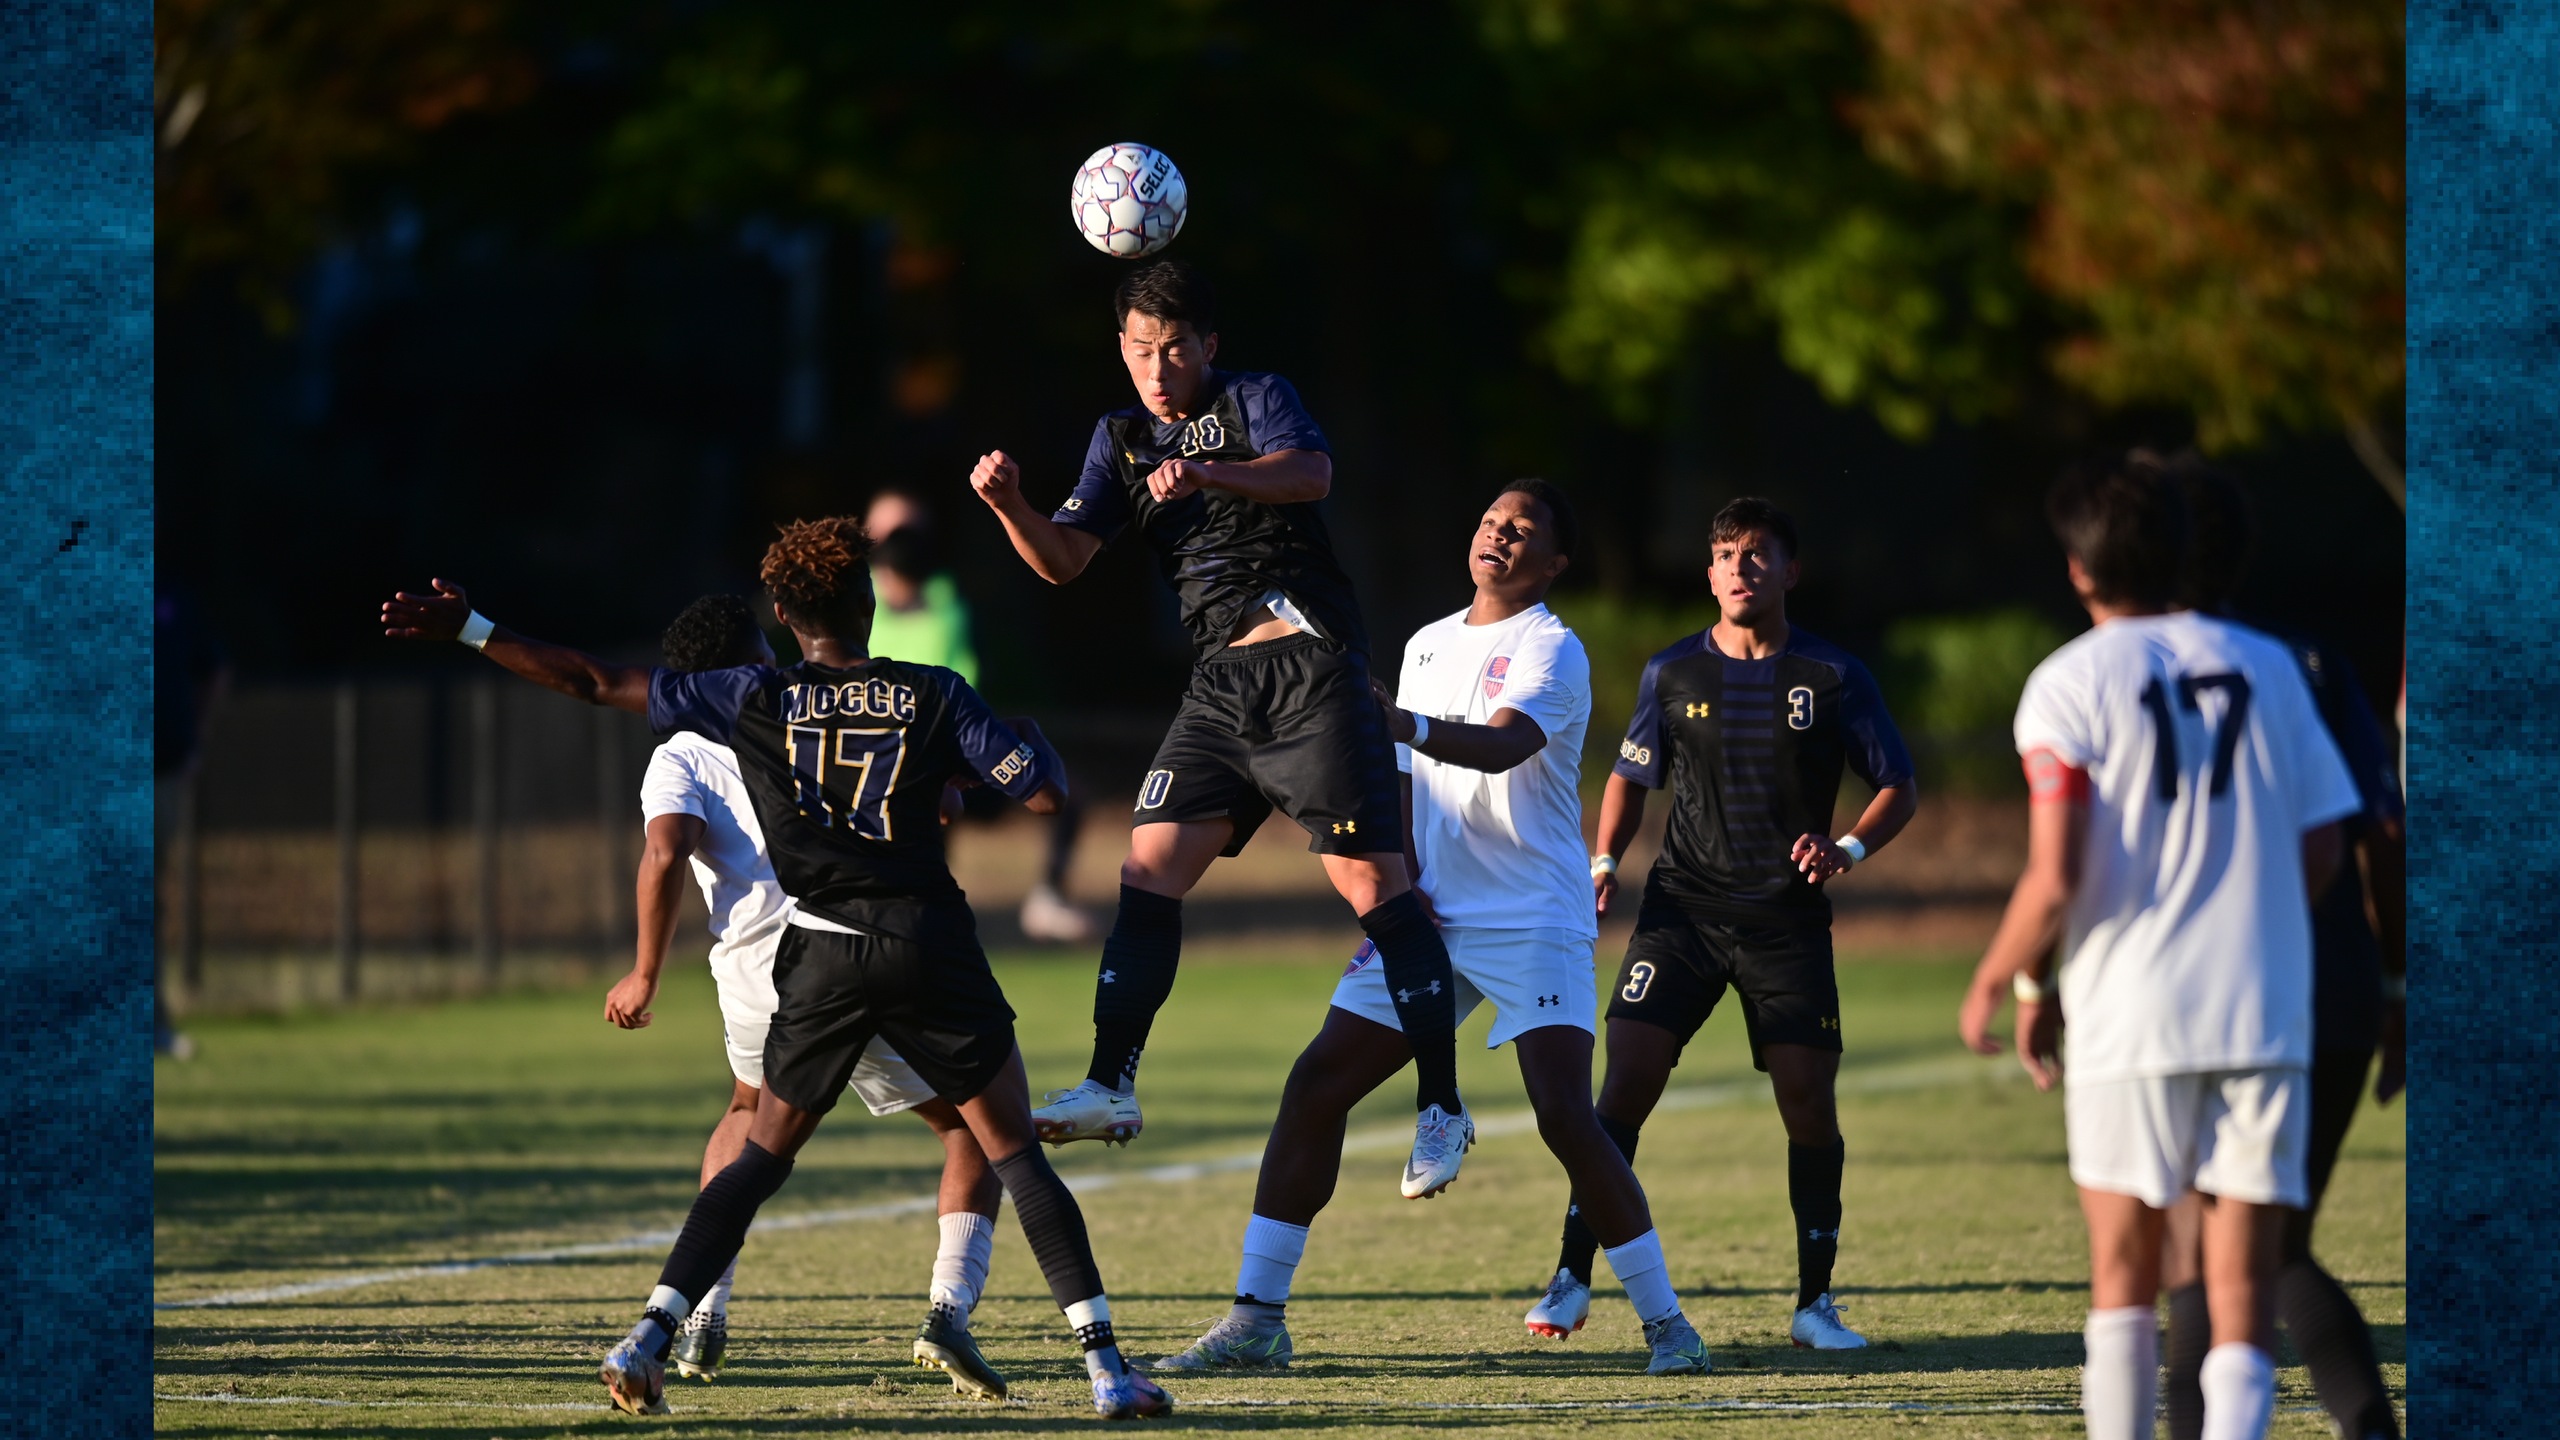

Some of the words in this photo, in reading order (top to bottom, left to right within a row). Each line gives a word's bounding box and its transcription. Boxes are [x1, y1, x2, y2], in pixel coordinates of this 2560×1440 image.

[1181, 414, 1224, 457] 10
[1787, 686, 1814, 731] 3
[2140, 669, 2254, 800] 17
[785, 725, 907, 841] 17
[1621, 960, 1656, 1003] 3
